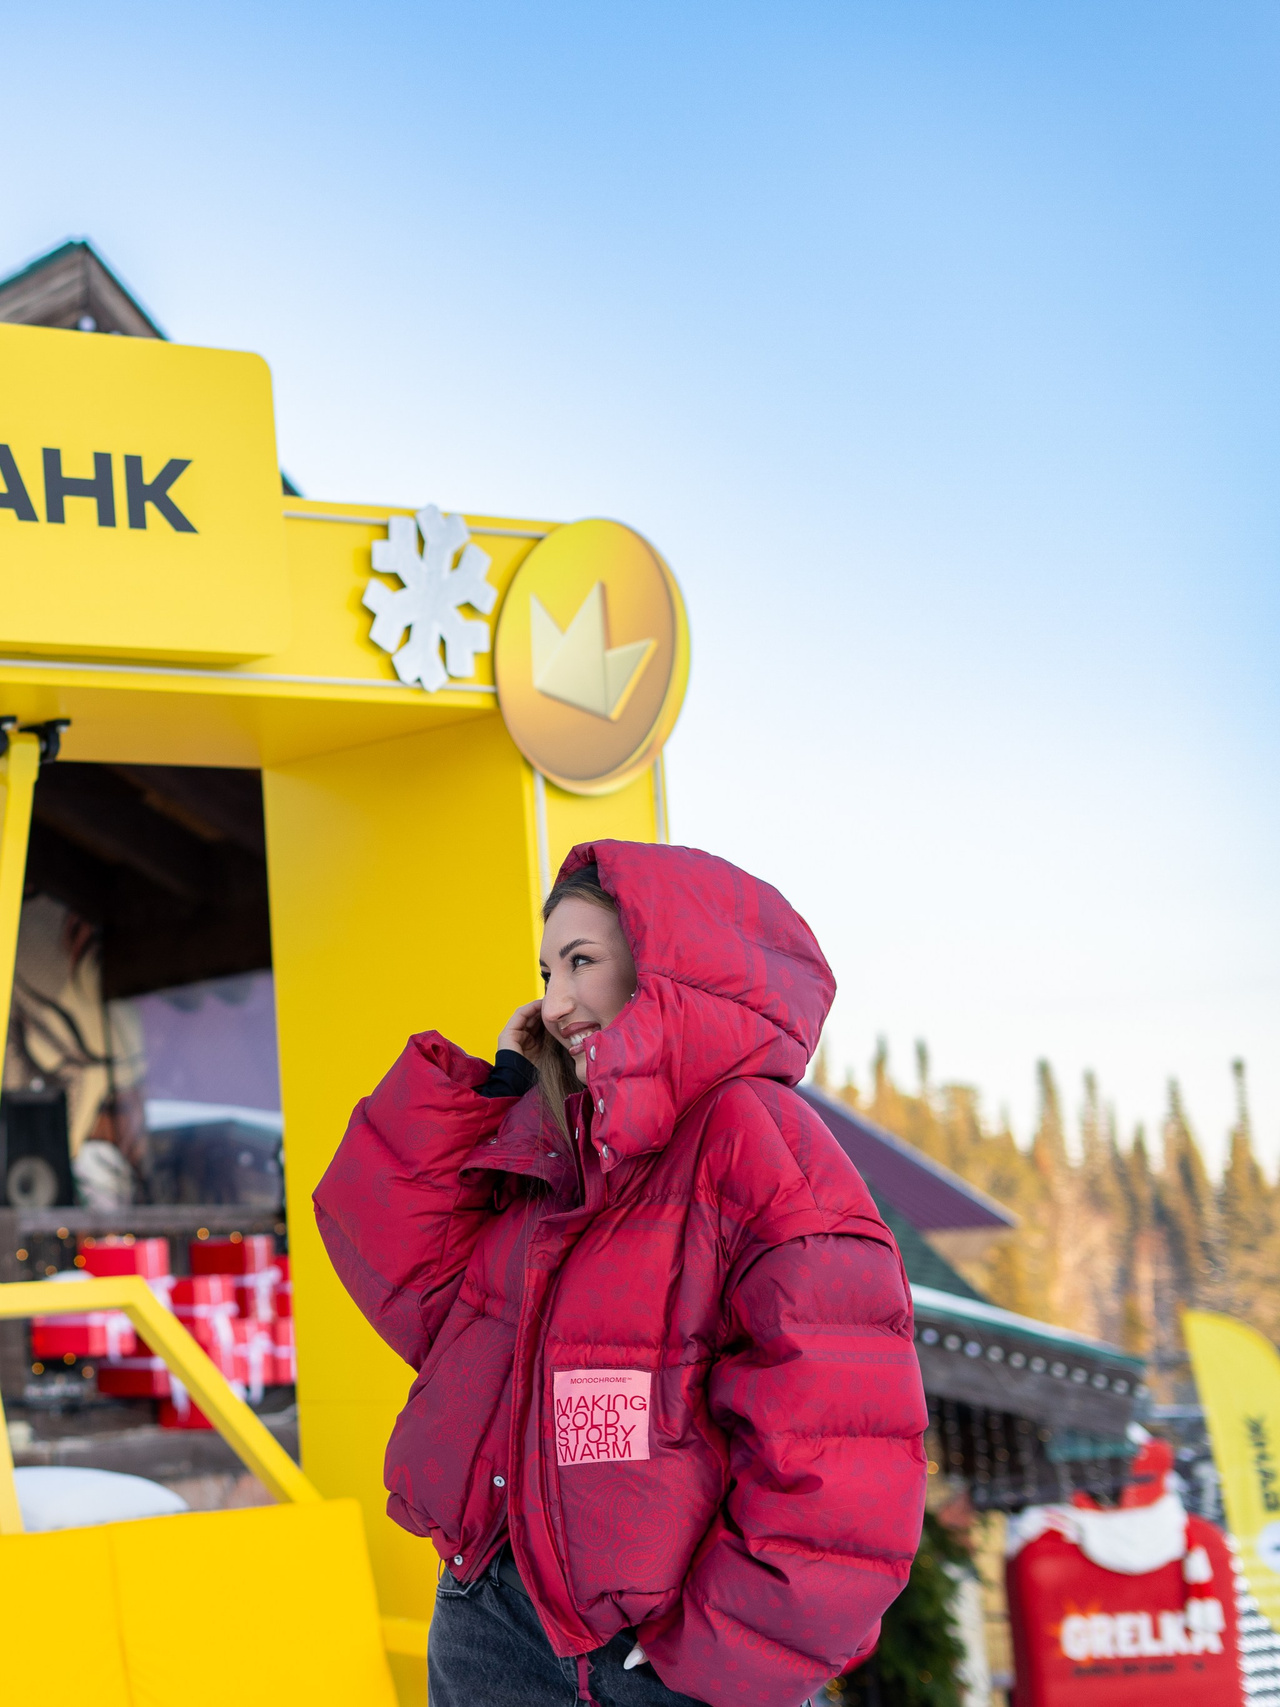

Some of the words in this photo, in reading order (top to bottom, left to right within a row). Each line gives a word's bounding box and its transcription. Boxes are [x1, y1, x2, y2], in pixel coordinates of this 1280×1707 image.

[556, 1394, 647, 1415] MAKING
[557, 1410, 620, 1431] COLD
[558, 1425, 636, 1446] STORY
[559, 1441, 632, 1463] WARM
